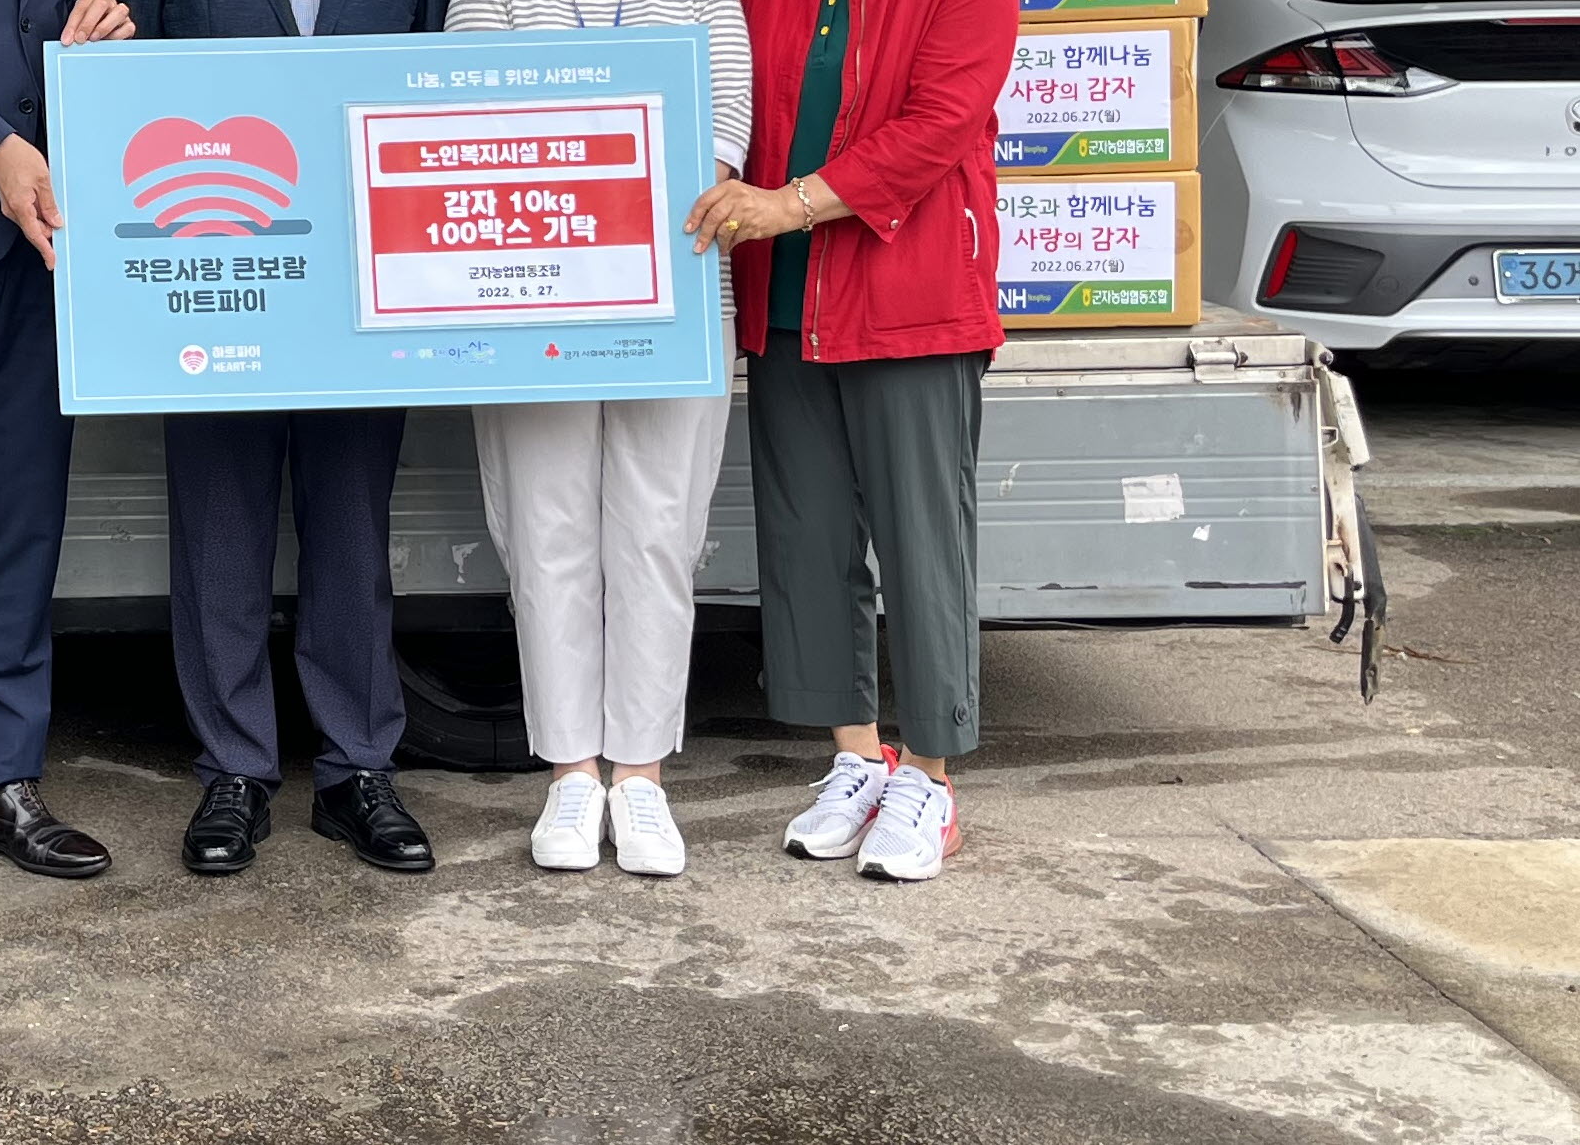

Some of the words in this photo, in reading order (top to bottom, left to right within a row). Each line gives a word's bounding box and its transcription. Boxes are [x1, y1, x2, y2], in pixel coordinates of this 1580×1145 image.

[1063, 45, 1152, 69] 함께나눔
[505, 68, 538, 85] 위한
[544, 67, 611, 84] 사회백신
[1010, 79, 1078, 104] 사랑의
[1088, 76, 1136, 101] 감자
[1027, 109, 1120, 123] 2022.06.27(월)
[185, 142, 231, 157] ANSAN
[420, 141, 539, 167] 노인복지시설
[547, 140, 586, 162] 지원
[994, 141, 1022, 161] NH
[444, 189, 497, 218] 감자
[509, 190, 576, 214] 10kg
[996, 196, 1060, 218] 이웃과
[1067, 195, 1156, 218] 함께나눔
[426, 218, 532, 246] 100박스
[543, 215, 597, 243] 기탁
[1014, 227, 1082, 252] 사랑의
[1092, 226, 1140, 251] 감자
[124, 257, 224, 282] 작은사랑
[232, 256, 307, 280] 큰보람
[469, 264, 561, 280] 군자농업협동조합
[1031, 259, 1124, 273] 2022.06.27(월)
[167, 288, 266, 313] 하트파이
[478, 288, 514, 298] 2022.
[998, 288, 1027, 309] NH
[212, 361, 261, 373] HEART-FI
